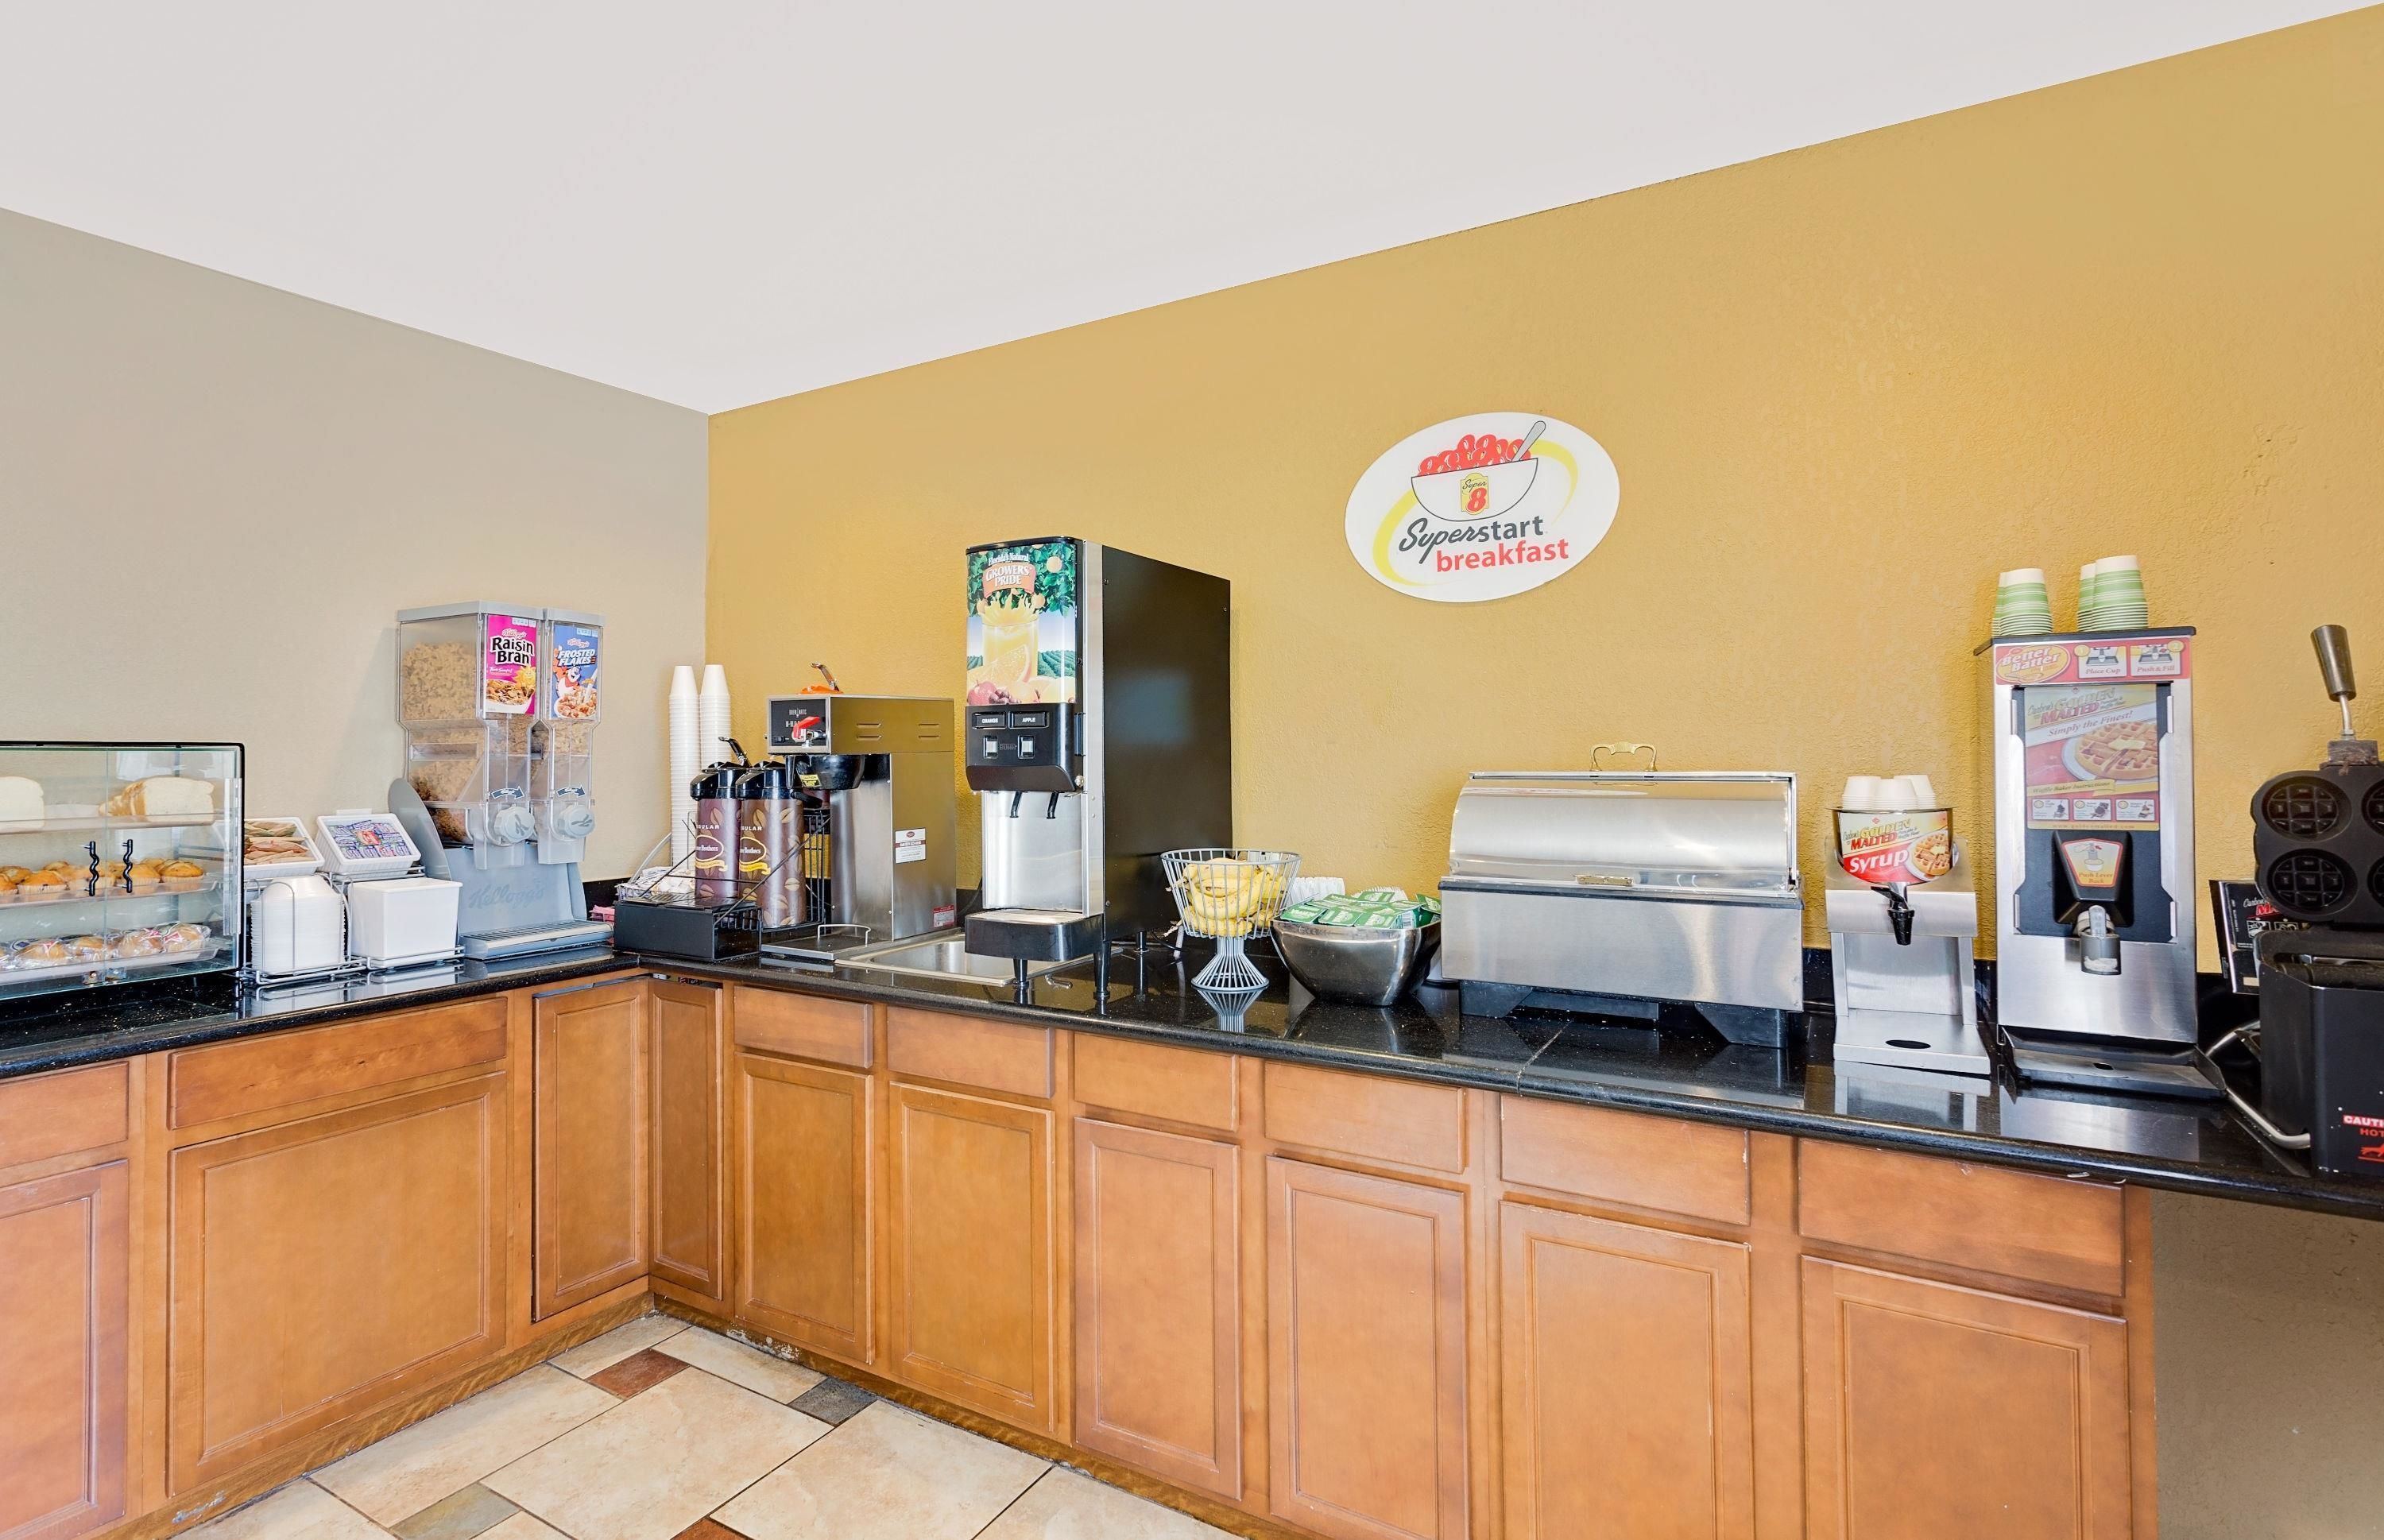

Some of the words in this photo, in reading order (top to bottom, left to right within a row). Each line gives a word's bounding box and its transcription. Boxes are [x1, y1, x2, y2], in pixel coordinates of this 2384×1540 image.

[1462, 478, 1488, 493] Super
[1465, 487, 1488, 513] 8
[1399, 515, 1544, 565] Superstart
[1009, 552, 1029, 562] Natural
[1436, 538, 1569, 573] breakfast
[994, 575, 1022, 587] PRIDE
[492, 637, 533, 655] Raisin
[558, 648, 596, 660] FROSTED
[497, 650, 529, 664] Bran
[558, 656, 591, 667] FLAKES
[2002, 647, 2052, 667] Better
[2011, 653, 2061, 673] Batter
[2040, 702, 2100, 725] MALTED
[2049, 724, 2081, 737] Simply
[2083, 718, 2097, 729] the
[2100, 710, 2134, 724] Finest!
[2072, 781, 2111, 790] Instructions
[1860, 818, 1911, 838] GOLDEN
[1851, 831, 1898, 850] MALTED
[1849, 849, 1909, 873] Syrup
[468, 884, 544, 909] Kellogg's
[2343, 1115, 2384, 1128] CAUTI
